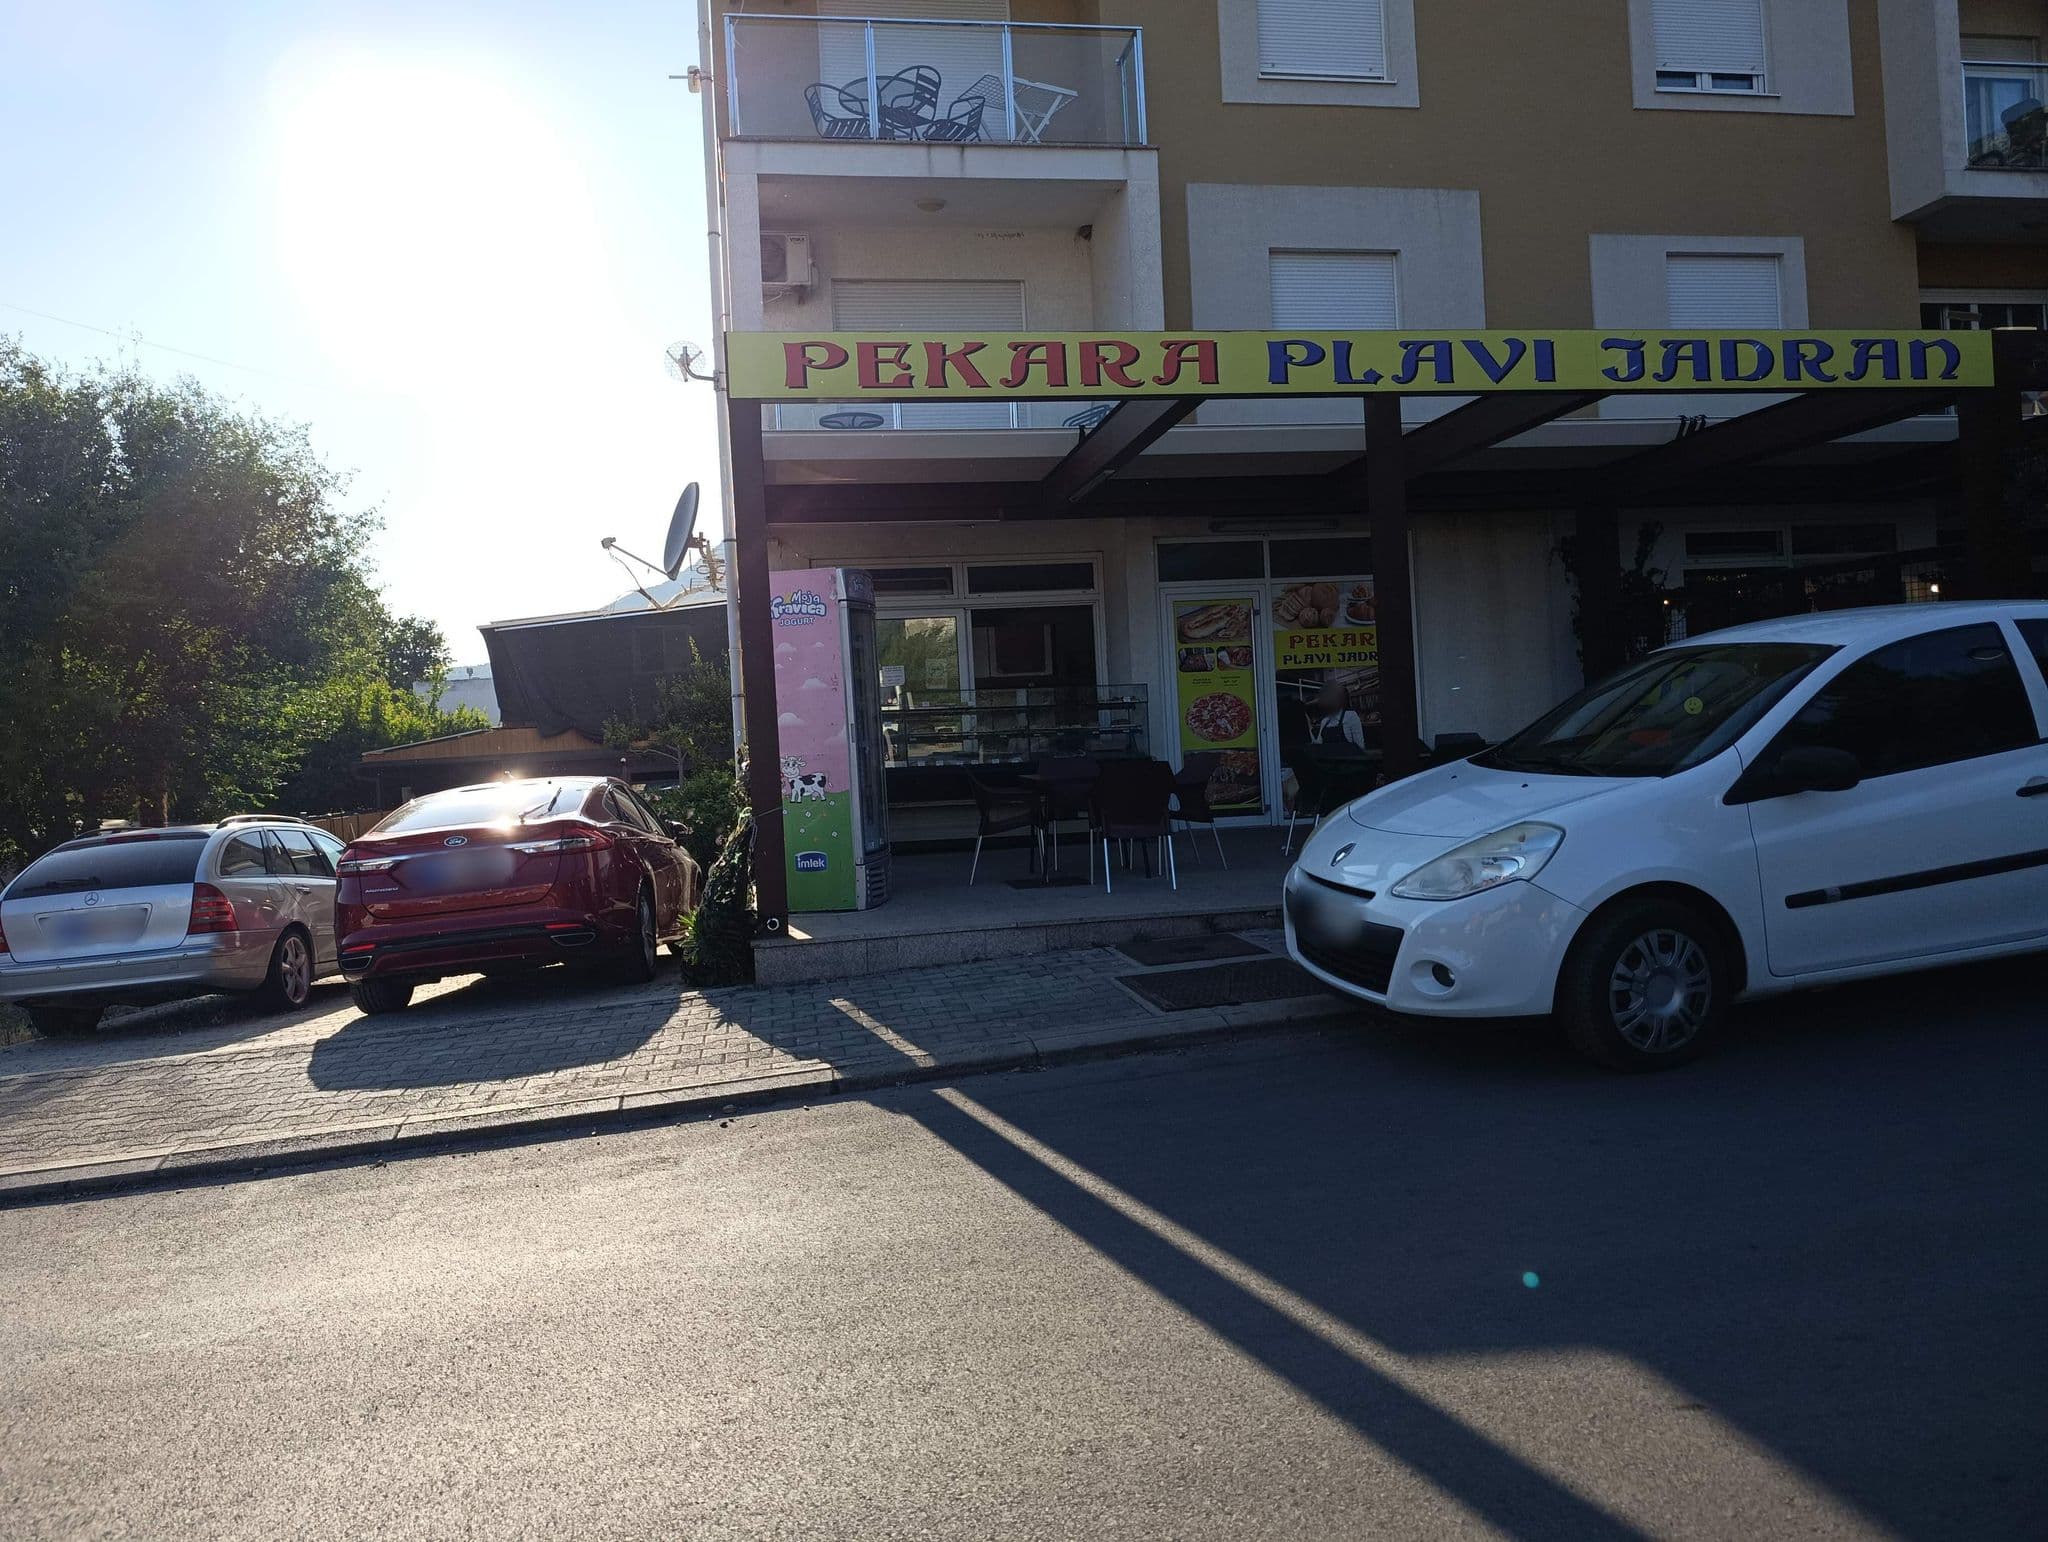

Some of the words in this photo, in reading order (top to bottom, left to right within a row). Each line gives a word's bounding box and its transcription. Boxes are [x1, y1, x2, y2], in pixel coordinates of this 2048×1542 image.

[783, 339, 1219, 390] PEKARA
[1267, 338, 1556, 388] PLAVI
[1601, 337, 1962, 383] JADRAN
[792, 590, 820, 605] Moja
[779, 617, 814, 627] JOGURT
[1289, 632, 1376, 649] PEKAR
[1282, 652, 1331, 665] PLAVI
[1337, 650, 1378, 663] JADR
[797, 856, 824, 868] imlek
